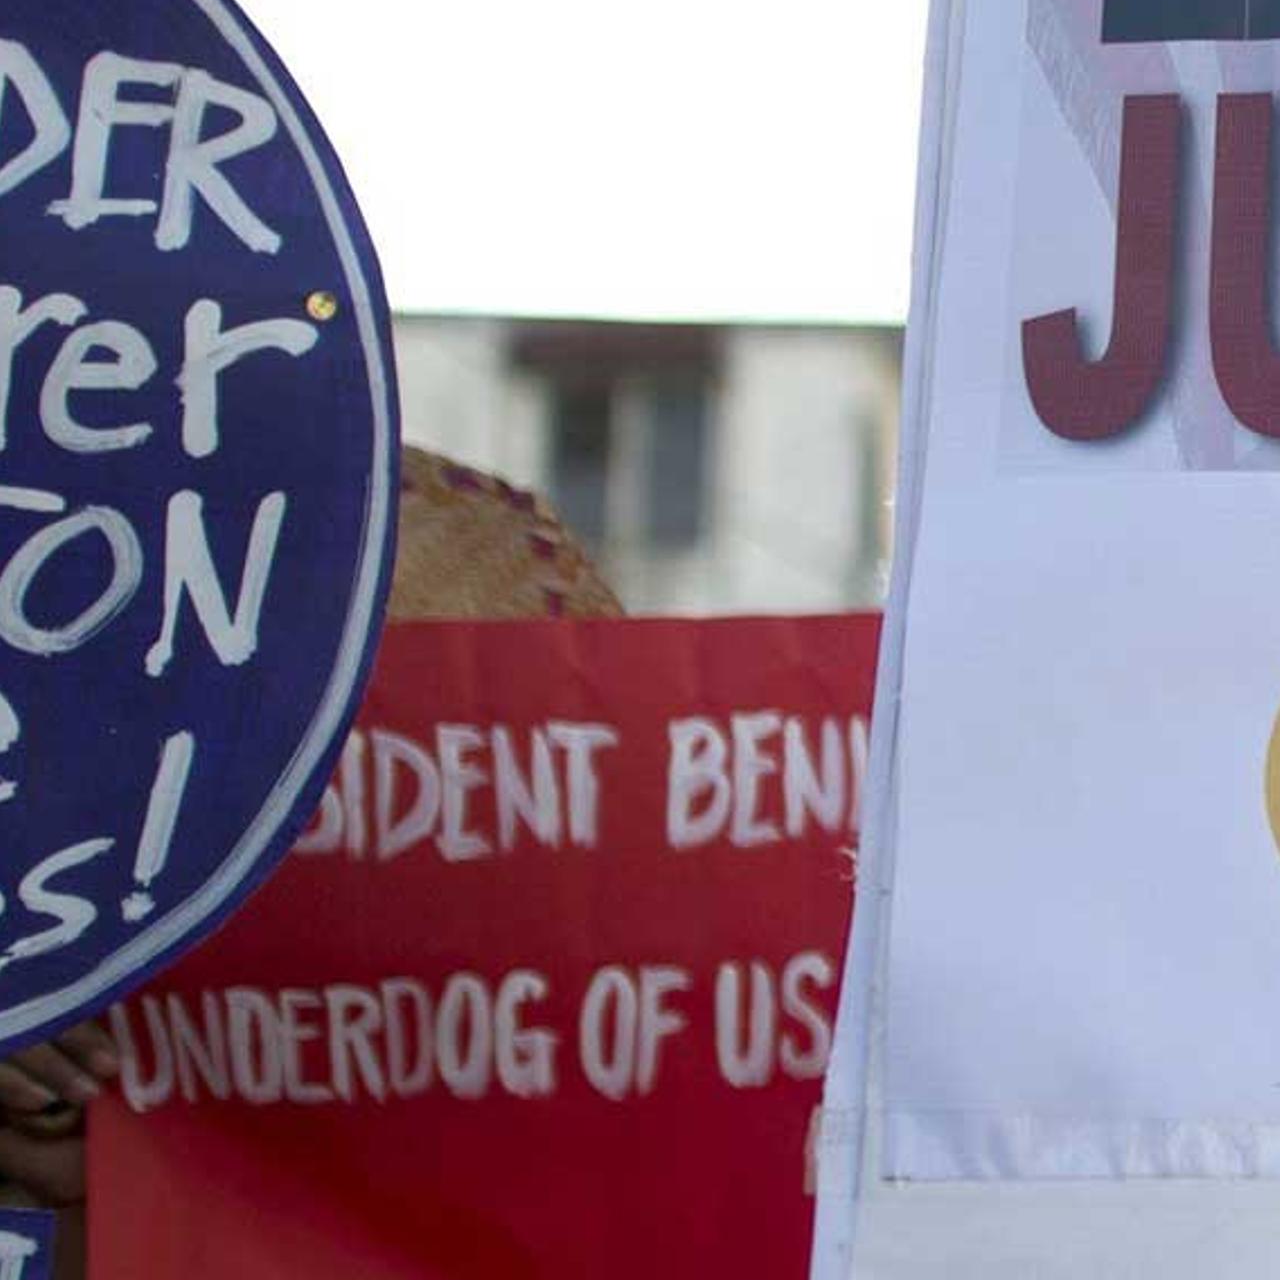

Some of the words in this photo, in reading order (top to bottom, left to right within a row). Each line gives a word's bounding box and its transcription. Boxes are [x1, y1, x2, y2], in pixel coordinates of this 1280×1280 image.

[0, 485, 286, 676] ON
[665, 710, 868, 850] BEN
[109, 972, 560, 1112] UNDERDOG
[578, 965, 690, 1100] OF
